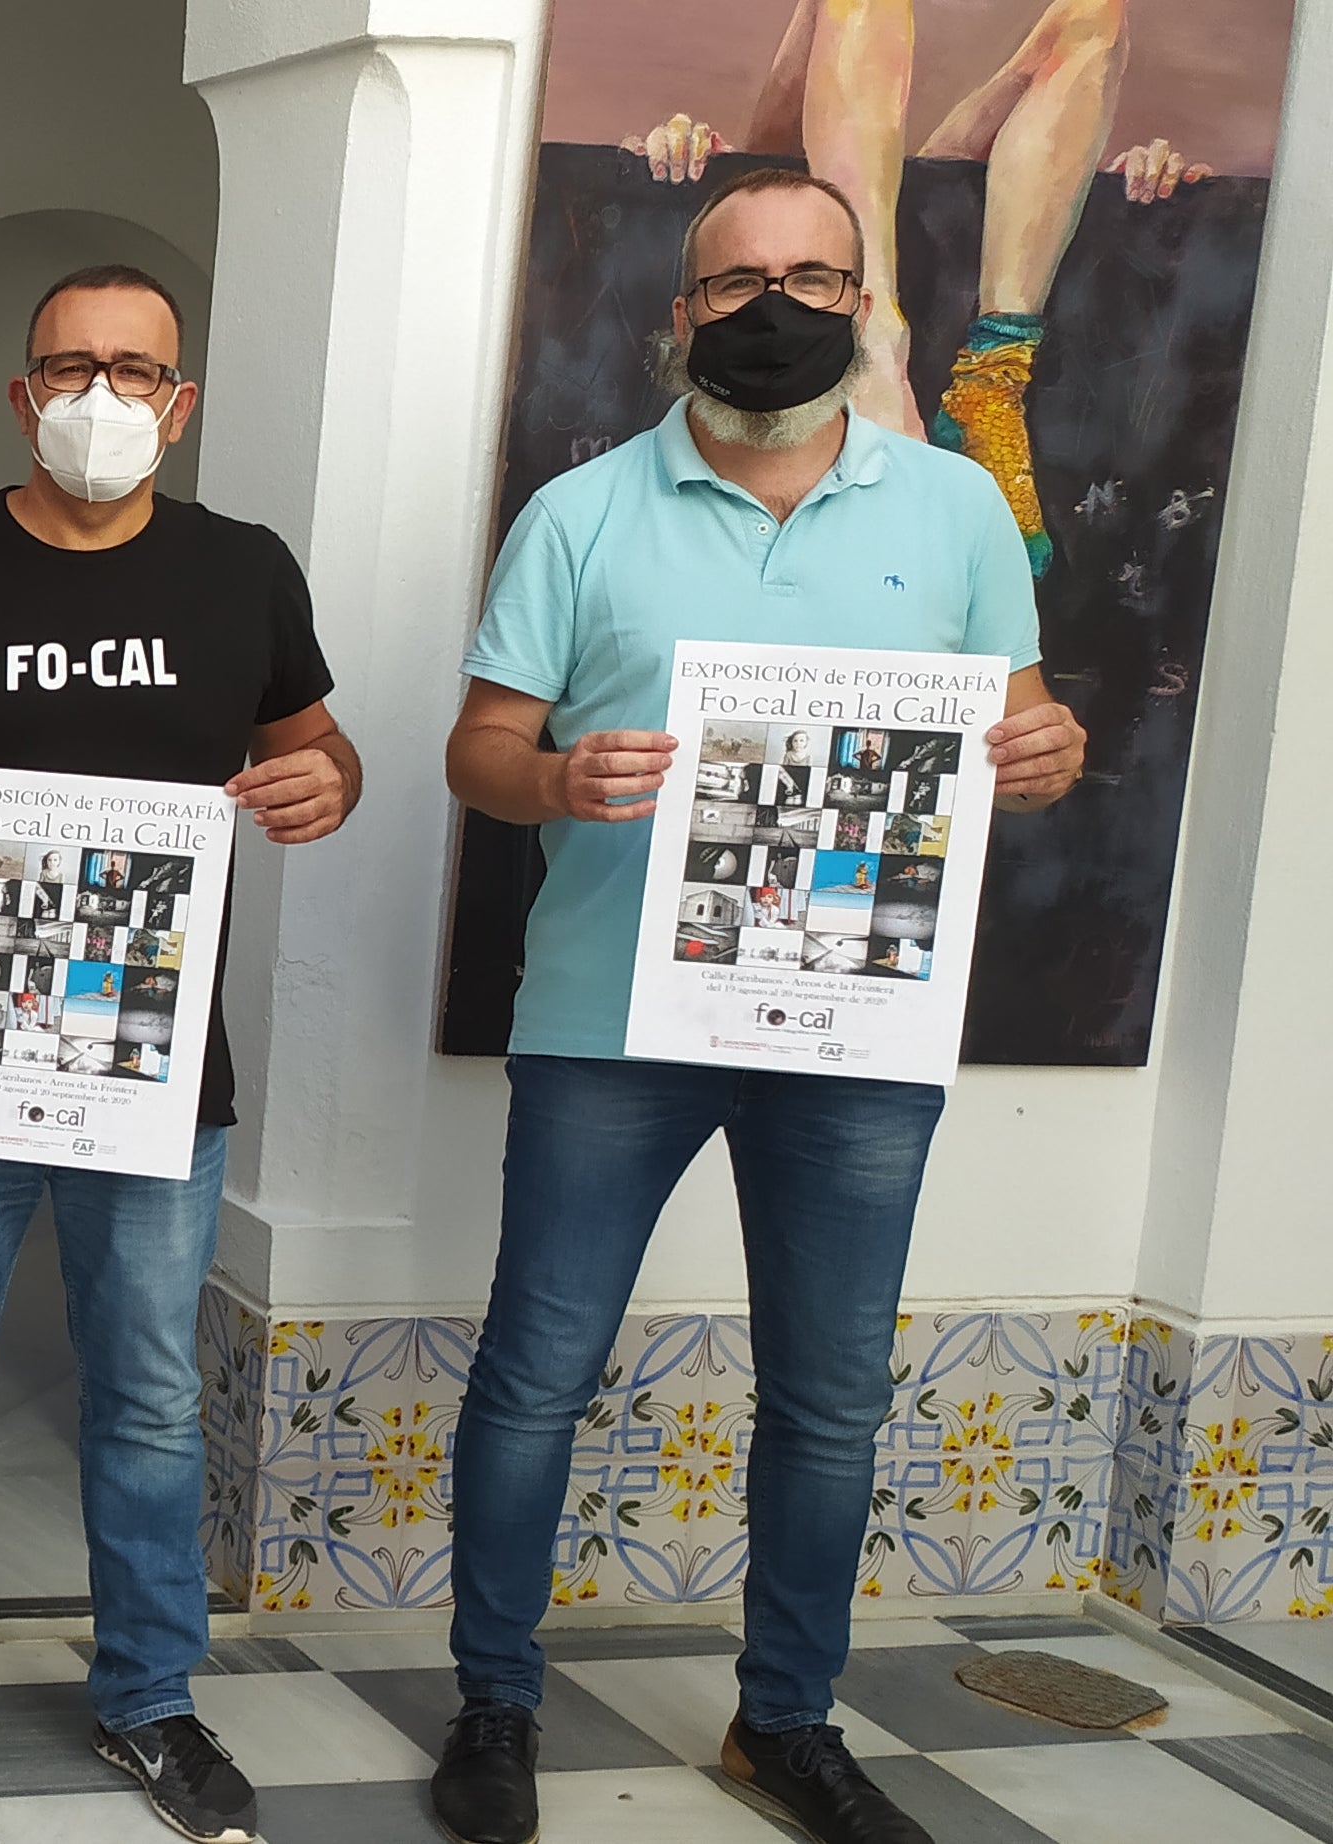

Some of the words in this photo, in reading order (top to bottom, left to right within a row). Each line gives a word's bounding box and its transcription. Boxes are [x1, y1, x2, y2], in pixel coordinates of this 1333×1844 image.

[6, 638, 177, 691] FO-CAL
[681, 661, 818, 684] EXPOSICIÓN
[824, 669, 846, 686] de
[854, 670, 998, 692] FOTOGRAFÍA
[698, 687, 797, 716] Fo-cal
[808, 699, 845, 719] en
[855, 693, 882, 721] la
[893, 696, 976, 726] Calle
[74, 794, 93, 810] de
[100, 798, 226, 822] FOTOGRAFÍA
[60, 823, 91, 841] en
[101, 818, 124, 844] la
[134, 822, 206, 850] Calle
[73, 1142, 95, 1152] FAF
